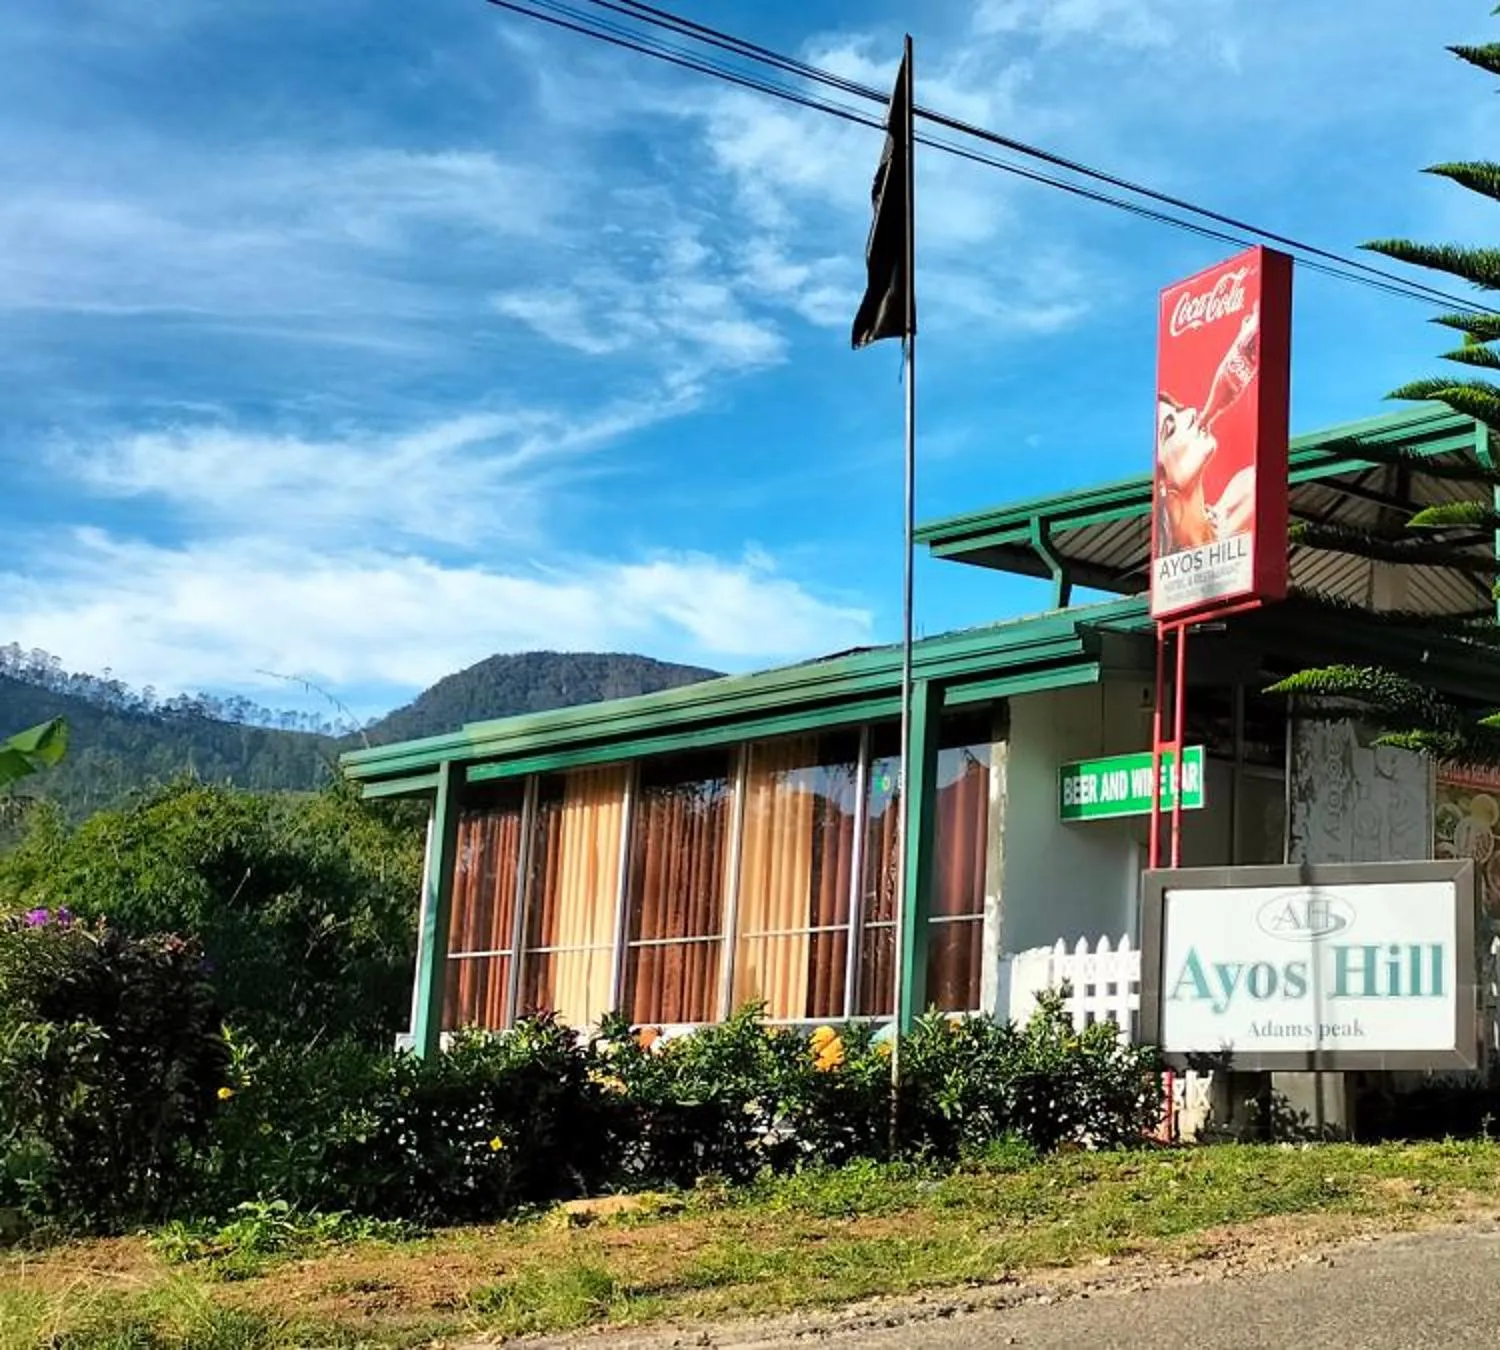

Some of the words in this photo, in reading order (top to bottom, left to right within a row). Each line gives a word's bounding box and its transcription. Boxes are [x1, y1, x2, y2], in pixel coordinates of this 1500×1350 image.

[1160, 551, 1203, 579] AYOS
[1209, 538, 1248, 567] HILL
[1063, 774, 1098, 806] BEER
[1100, 769, 1129, 801] AND
[1171, 944, 1308, 1015] Ayos
[1331, 944, 1447, 998] Hill
[1249, 1020, 1314, 1038] Adams
[1318, 1018, 1365, 1041] peak
